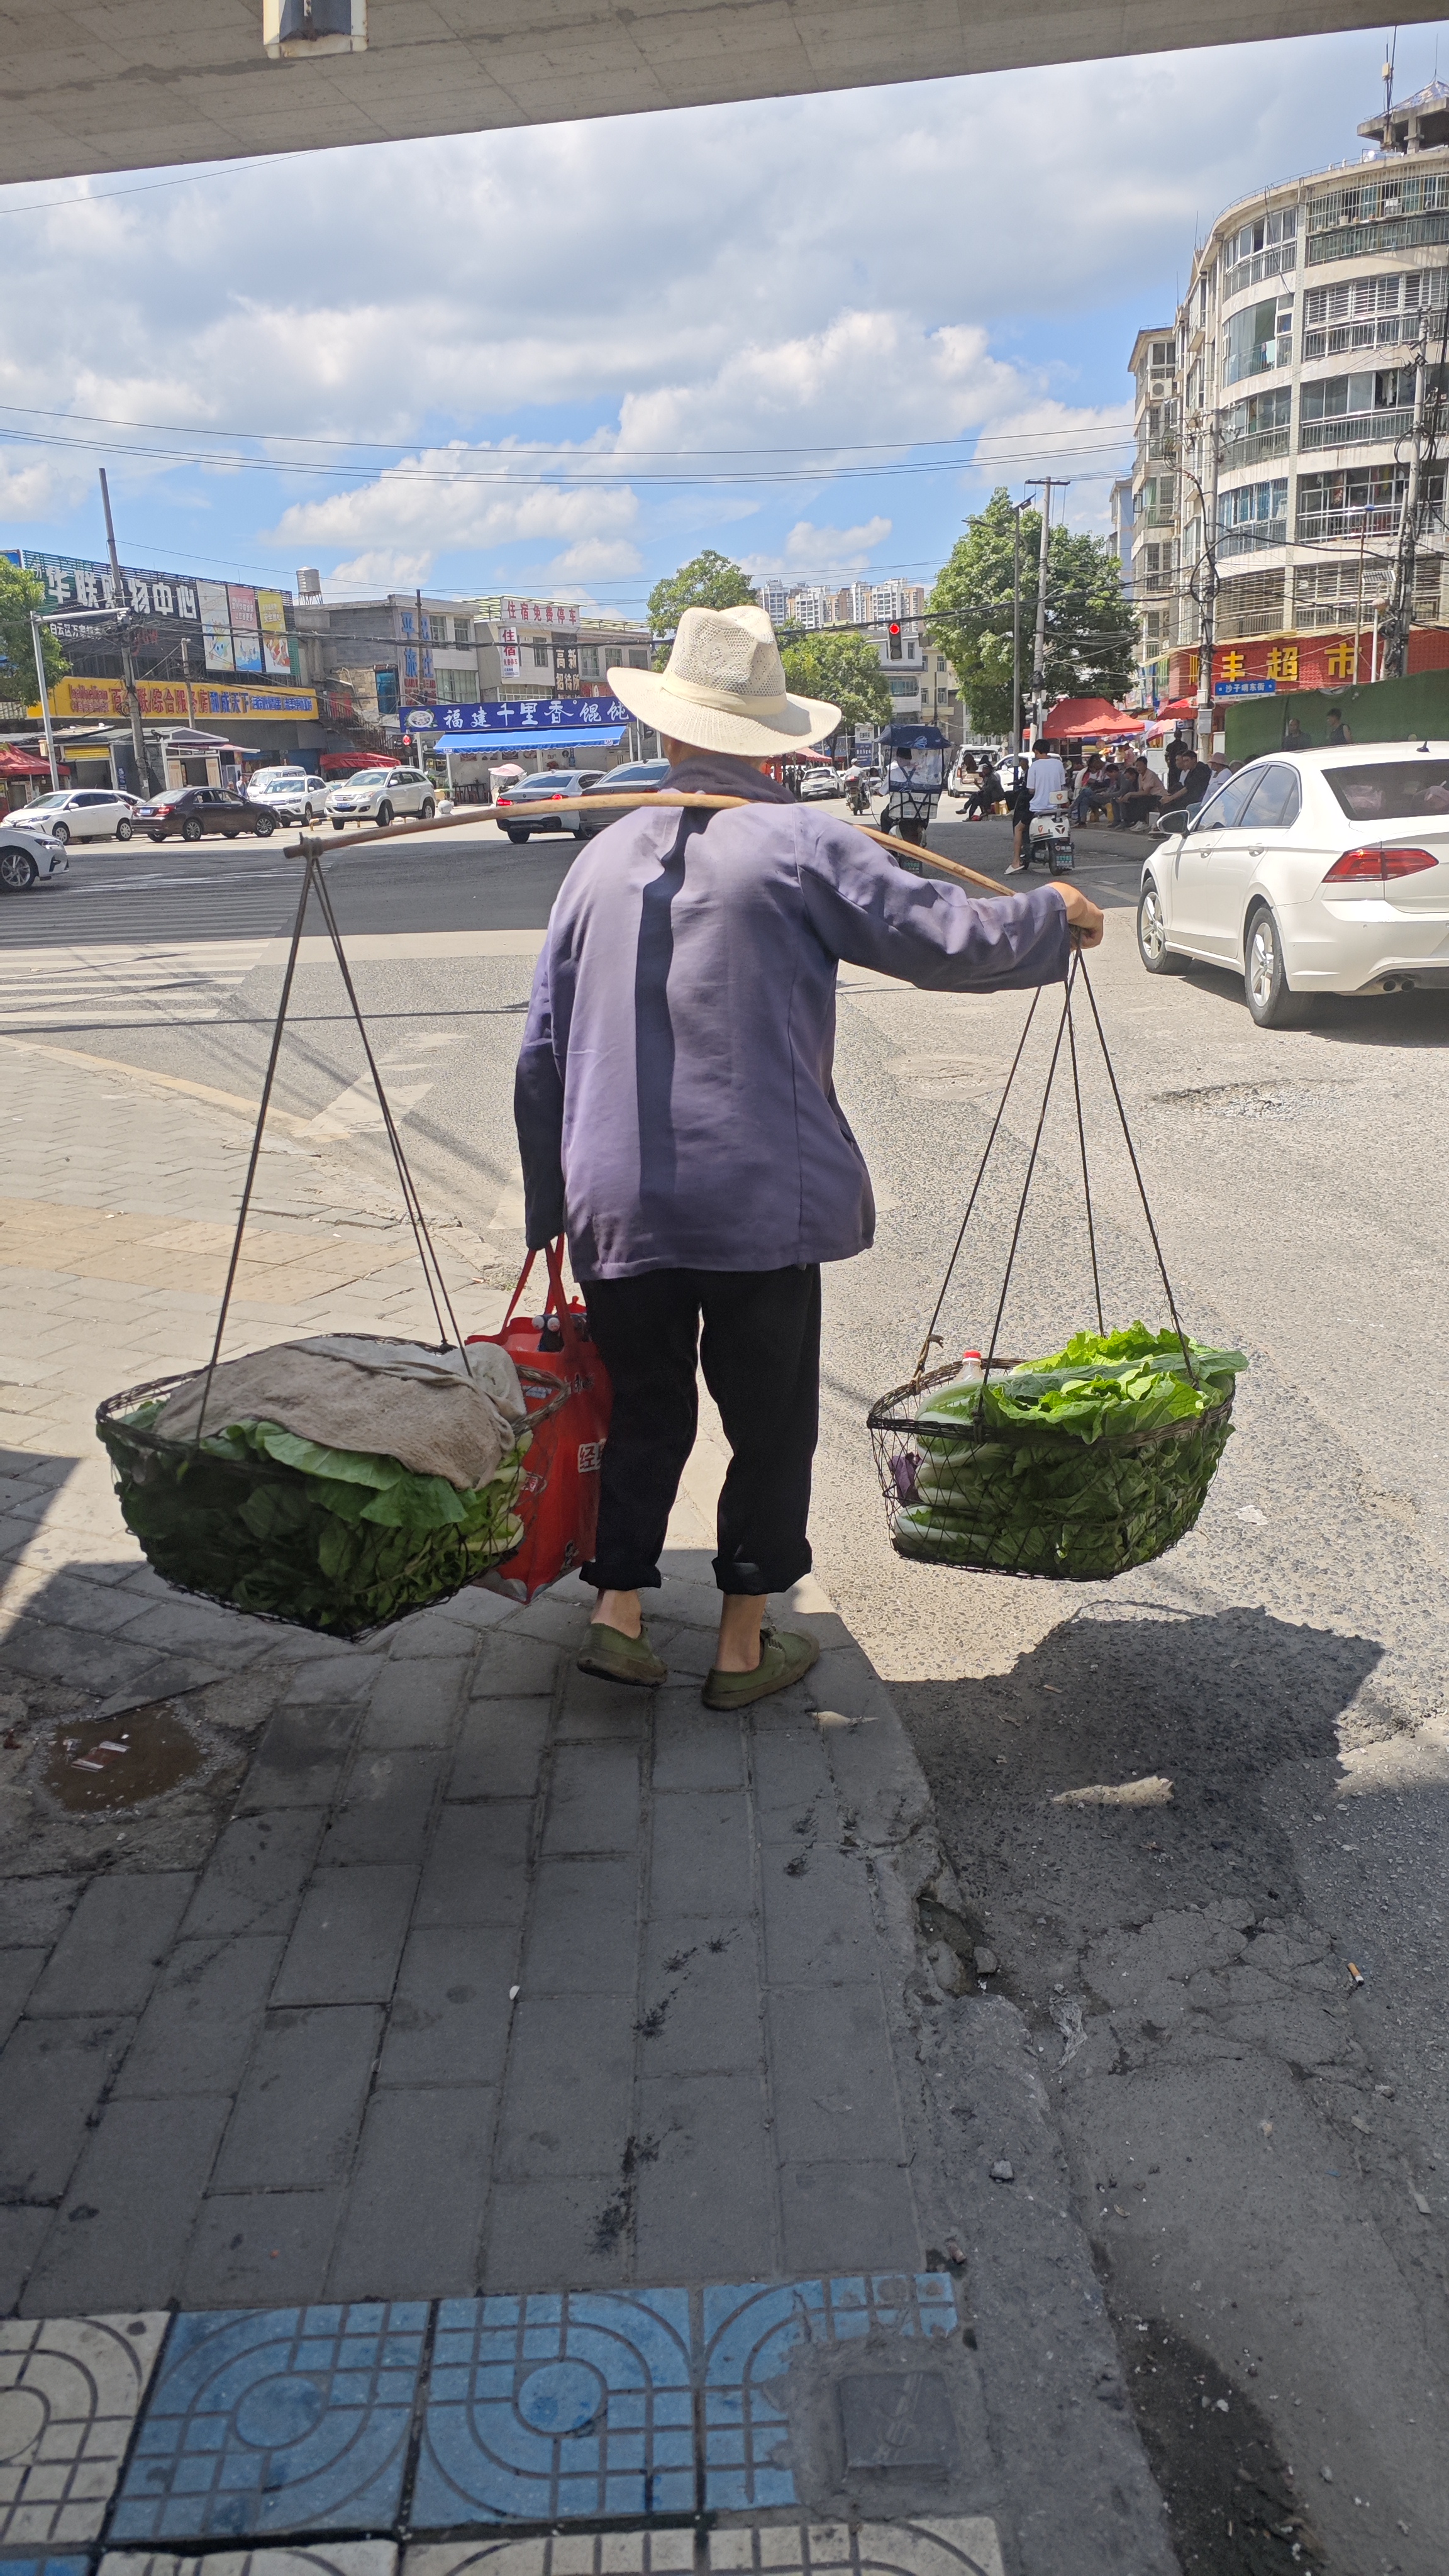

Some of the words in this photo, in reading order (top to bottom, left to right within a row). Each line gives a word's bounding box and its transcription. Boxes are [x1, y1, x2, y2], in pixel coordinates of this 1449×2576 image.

[46, 567, 197, 619] 华联购物中心
[507, 600, 577, 625] 住宿免费停车
[502, 629, 516, 656] 住宿
[555, 648, 577, 669] 高新
[555, 672, 580, 691] 招待所
[1225, 682, 1265, 694] 沙子哨东街
[443, 700, 629, 729] 福建千里香馄饨
